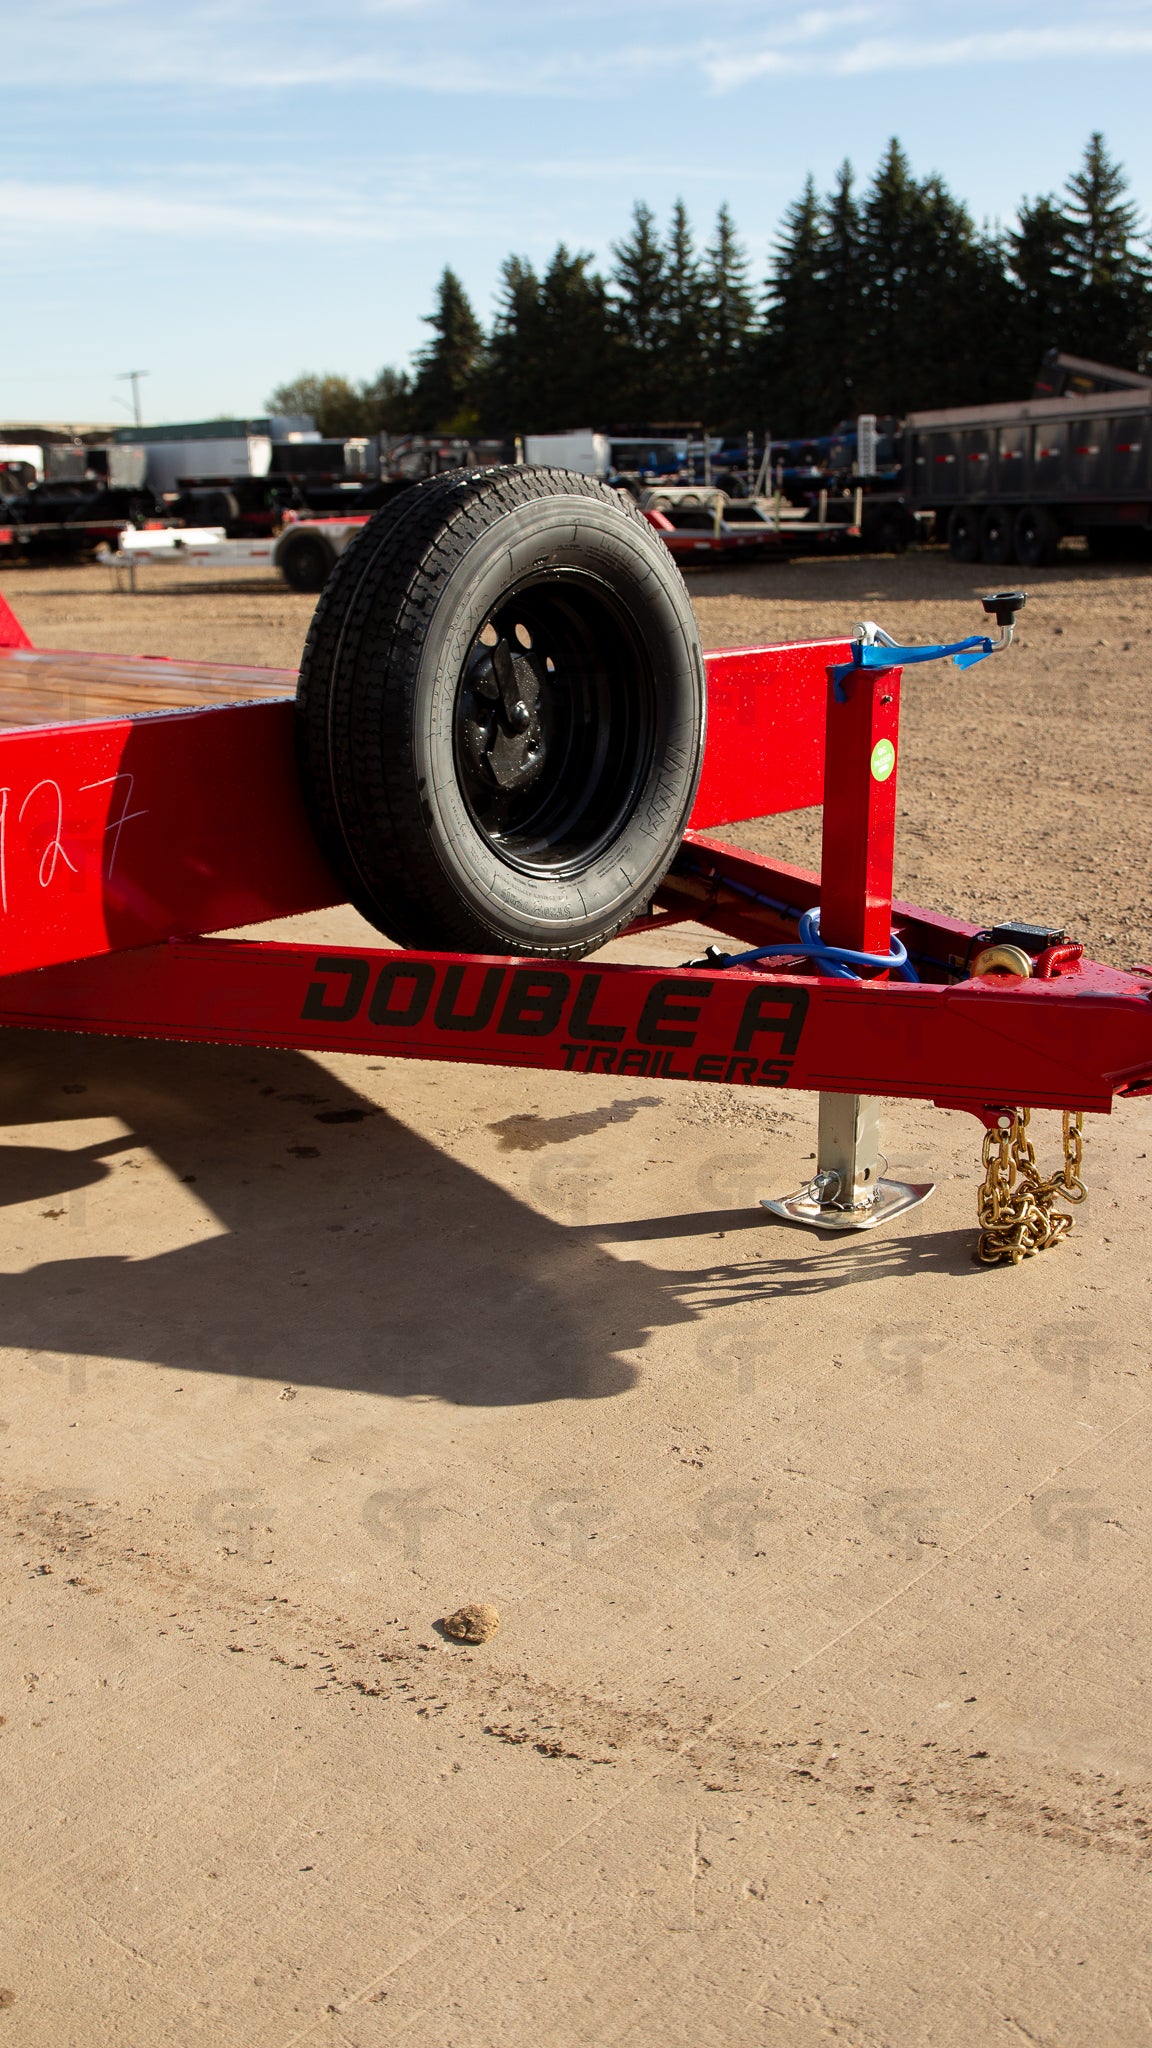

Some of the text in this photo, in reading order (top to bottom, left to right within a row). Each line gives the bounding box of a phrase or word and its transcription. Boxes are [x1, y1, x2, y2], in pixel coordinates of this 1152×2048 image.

[301, 957, 811, 1056] DOUBLE A
[560, 1043, 794, 1087] TRAILERS
